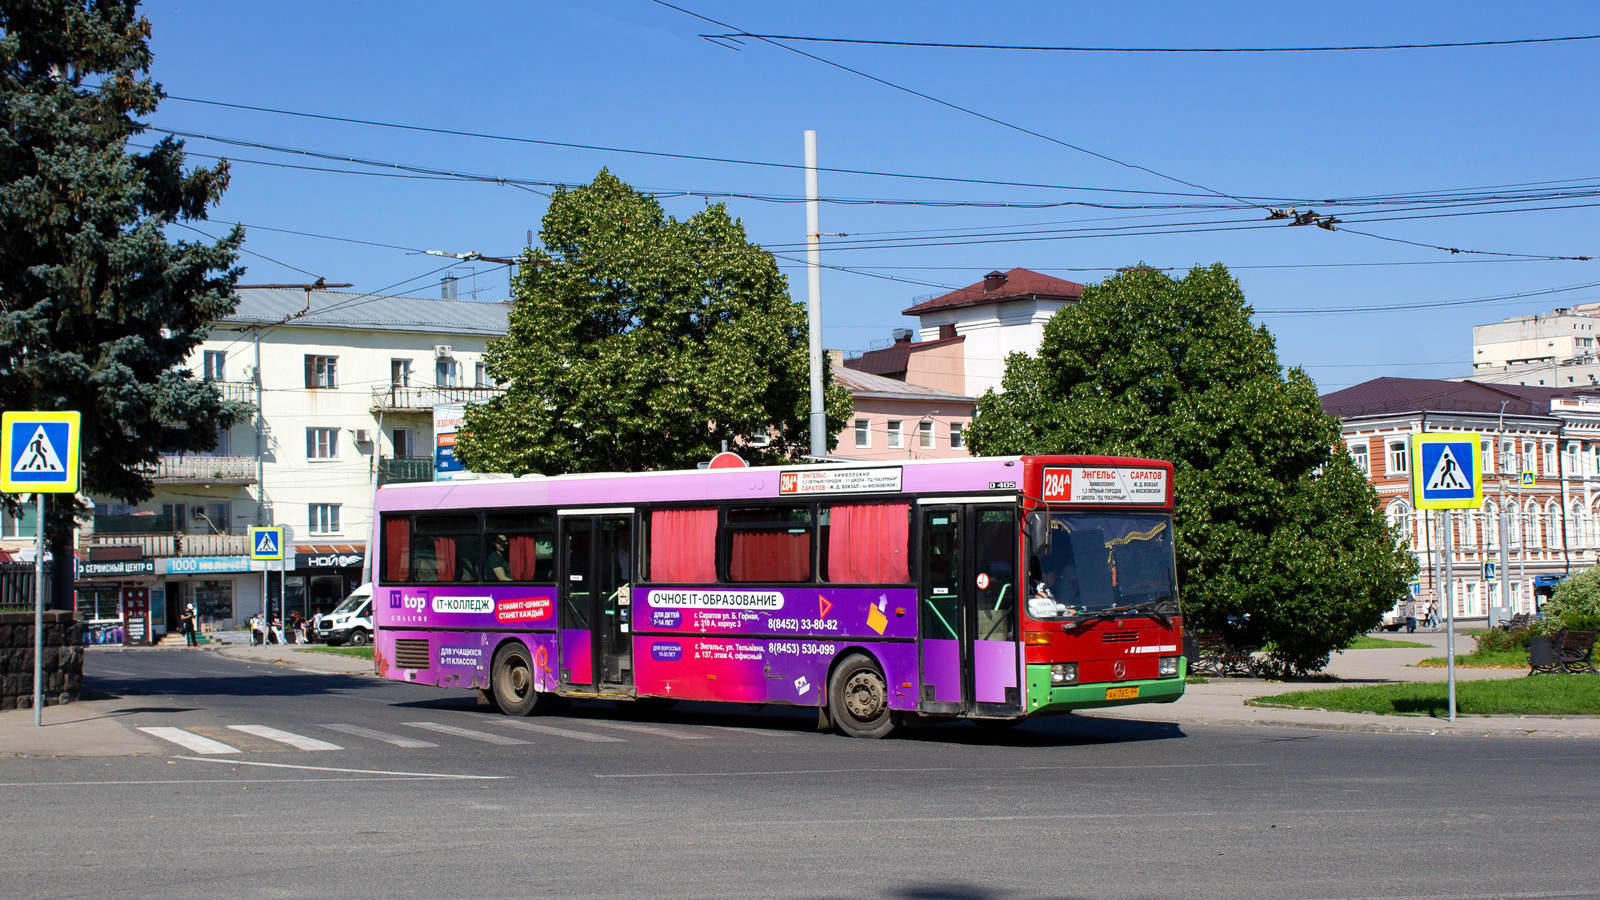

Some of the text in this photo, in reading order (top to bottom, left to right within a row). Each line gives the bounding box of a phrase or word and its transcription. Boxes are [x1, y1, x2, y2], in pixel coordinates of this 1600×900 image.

[1081, 470, 1162, 480] ЭНГЕЛЬС САРАТОВ
[171, 560, 196, 571] 1000
[308, 554, 338, 567] НОЙ
[85, 562, 146, 573] СЕРВИСНЫЙ ЦЕНТР
[391, 593, 426, 613] IT top
[436, 599, 489, 611] IT-КОЛЛЕДЖ
[653, 593, 777, 606] ОЧНОЕ IT-ОБРАЗОВАНИЕ
[498, 600, 549, 611] С НАМИ IT-ШНИКОМ
[498, 608, 544, 620] СТАНЕТ КАЖДЫЙ
[664, 611, 680, 619] ДЕТЕЙ
[698, 611, 722, 620] Саратов
[738, 612, 759, 621] Горная,
[700, 619, 710, 627] 310
[768, 618, 838, 632] 8(8452) 33-80-82
[440, 647, 482, 657] ДЛЯ УЧАЩИХСЯ
[700, 642, 725, 651] Энгельс,
[735, 643, 765, 653] Тельмана,
[768, 642, 835, 656] 8(8453) 530-099
[702, 651, 713, 659] 137,
[734, 652, 763, 660] офисный
[452, 657, 477, 666] КЛАССОВ
